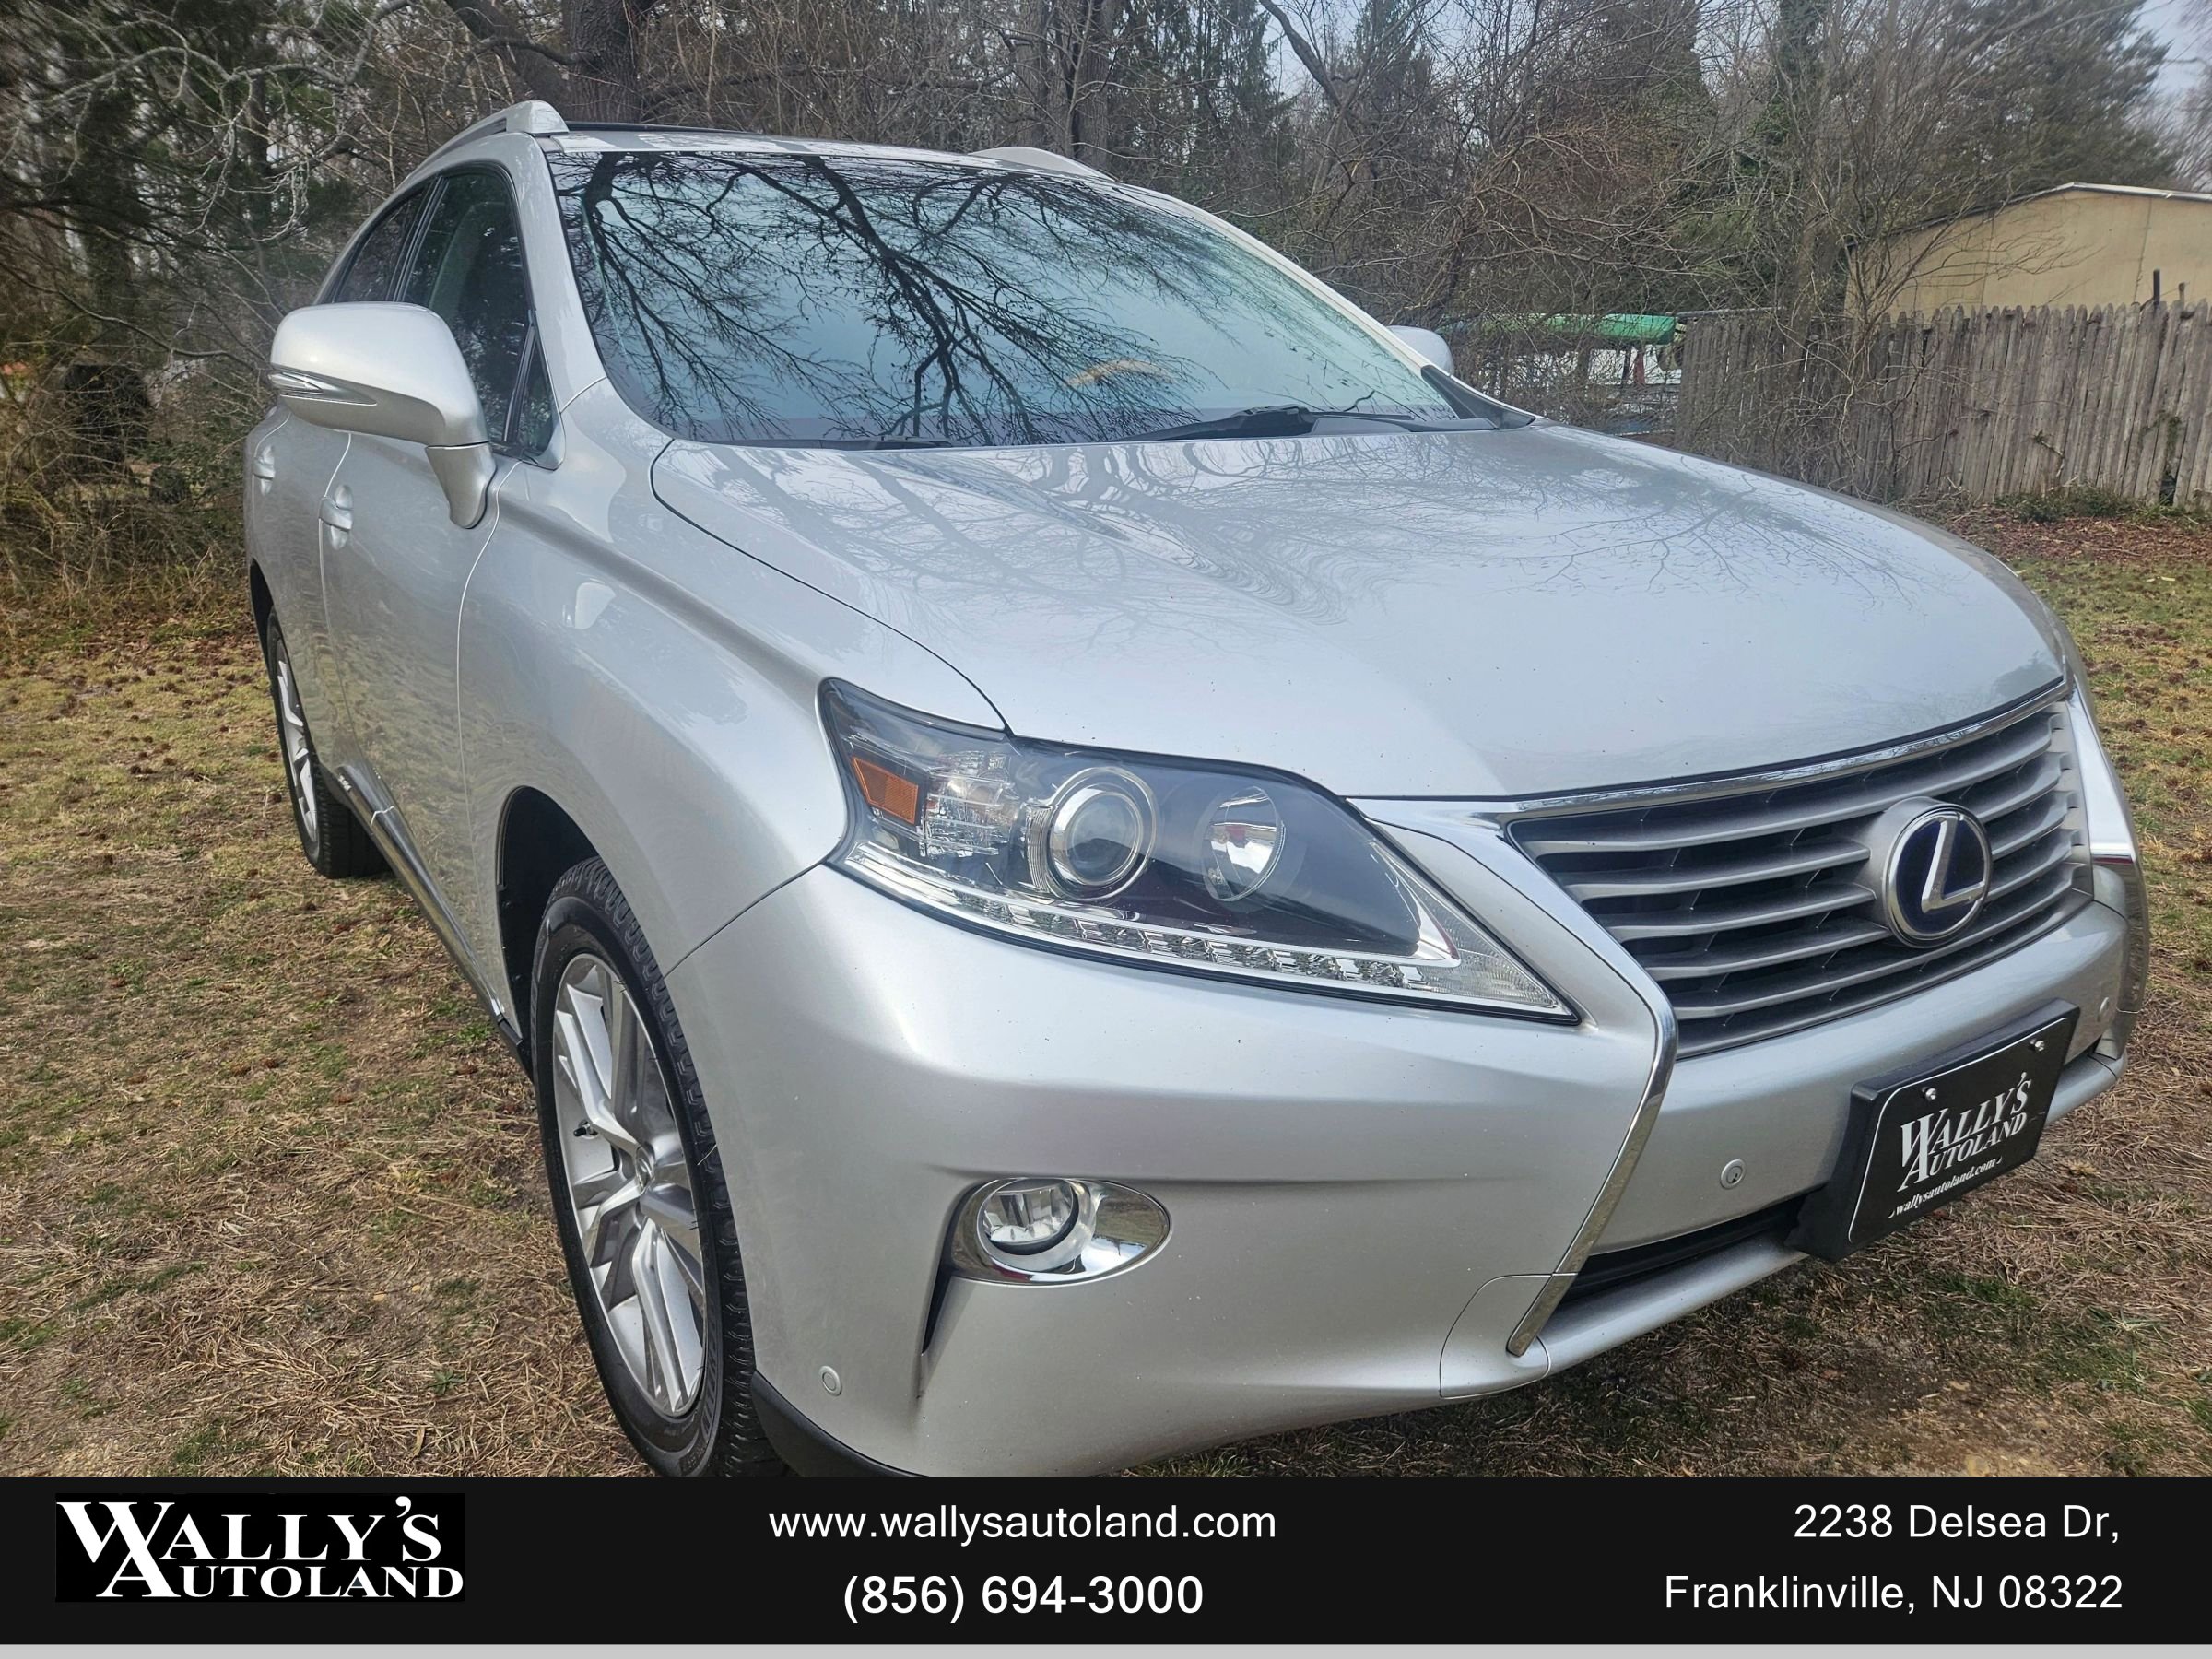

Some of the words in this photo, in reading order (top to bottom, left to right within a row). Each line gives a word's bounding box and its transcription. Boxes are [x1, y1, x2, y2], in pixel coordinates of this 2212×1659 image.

[1896, 1112, 2027, 1193] AUTOLAND
[1900, 1071, 2032, 1168] WALLY'S
[1896, 1158, 1996, 1215] wallysautoland.com
